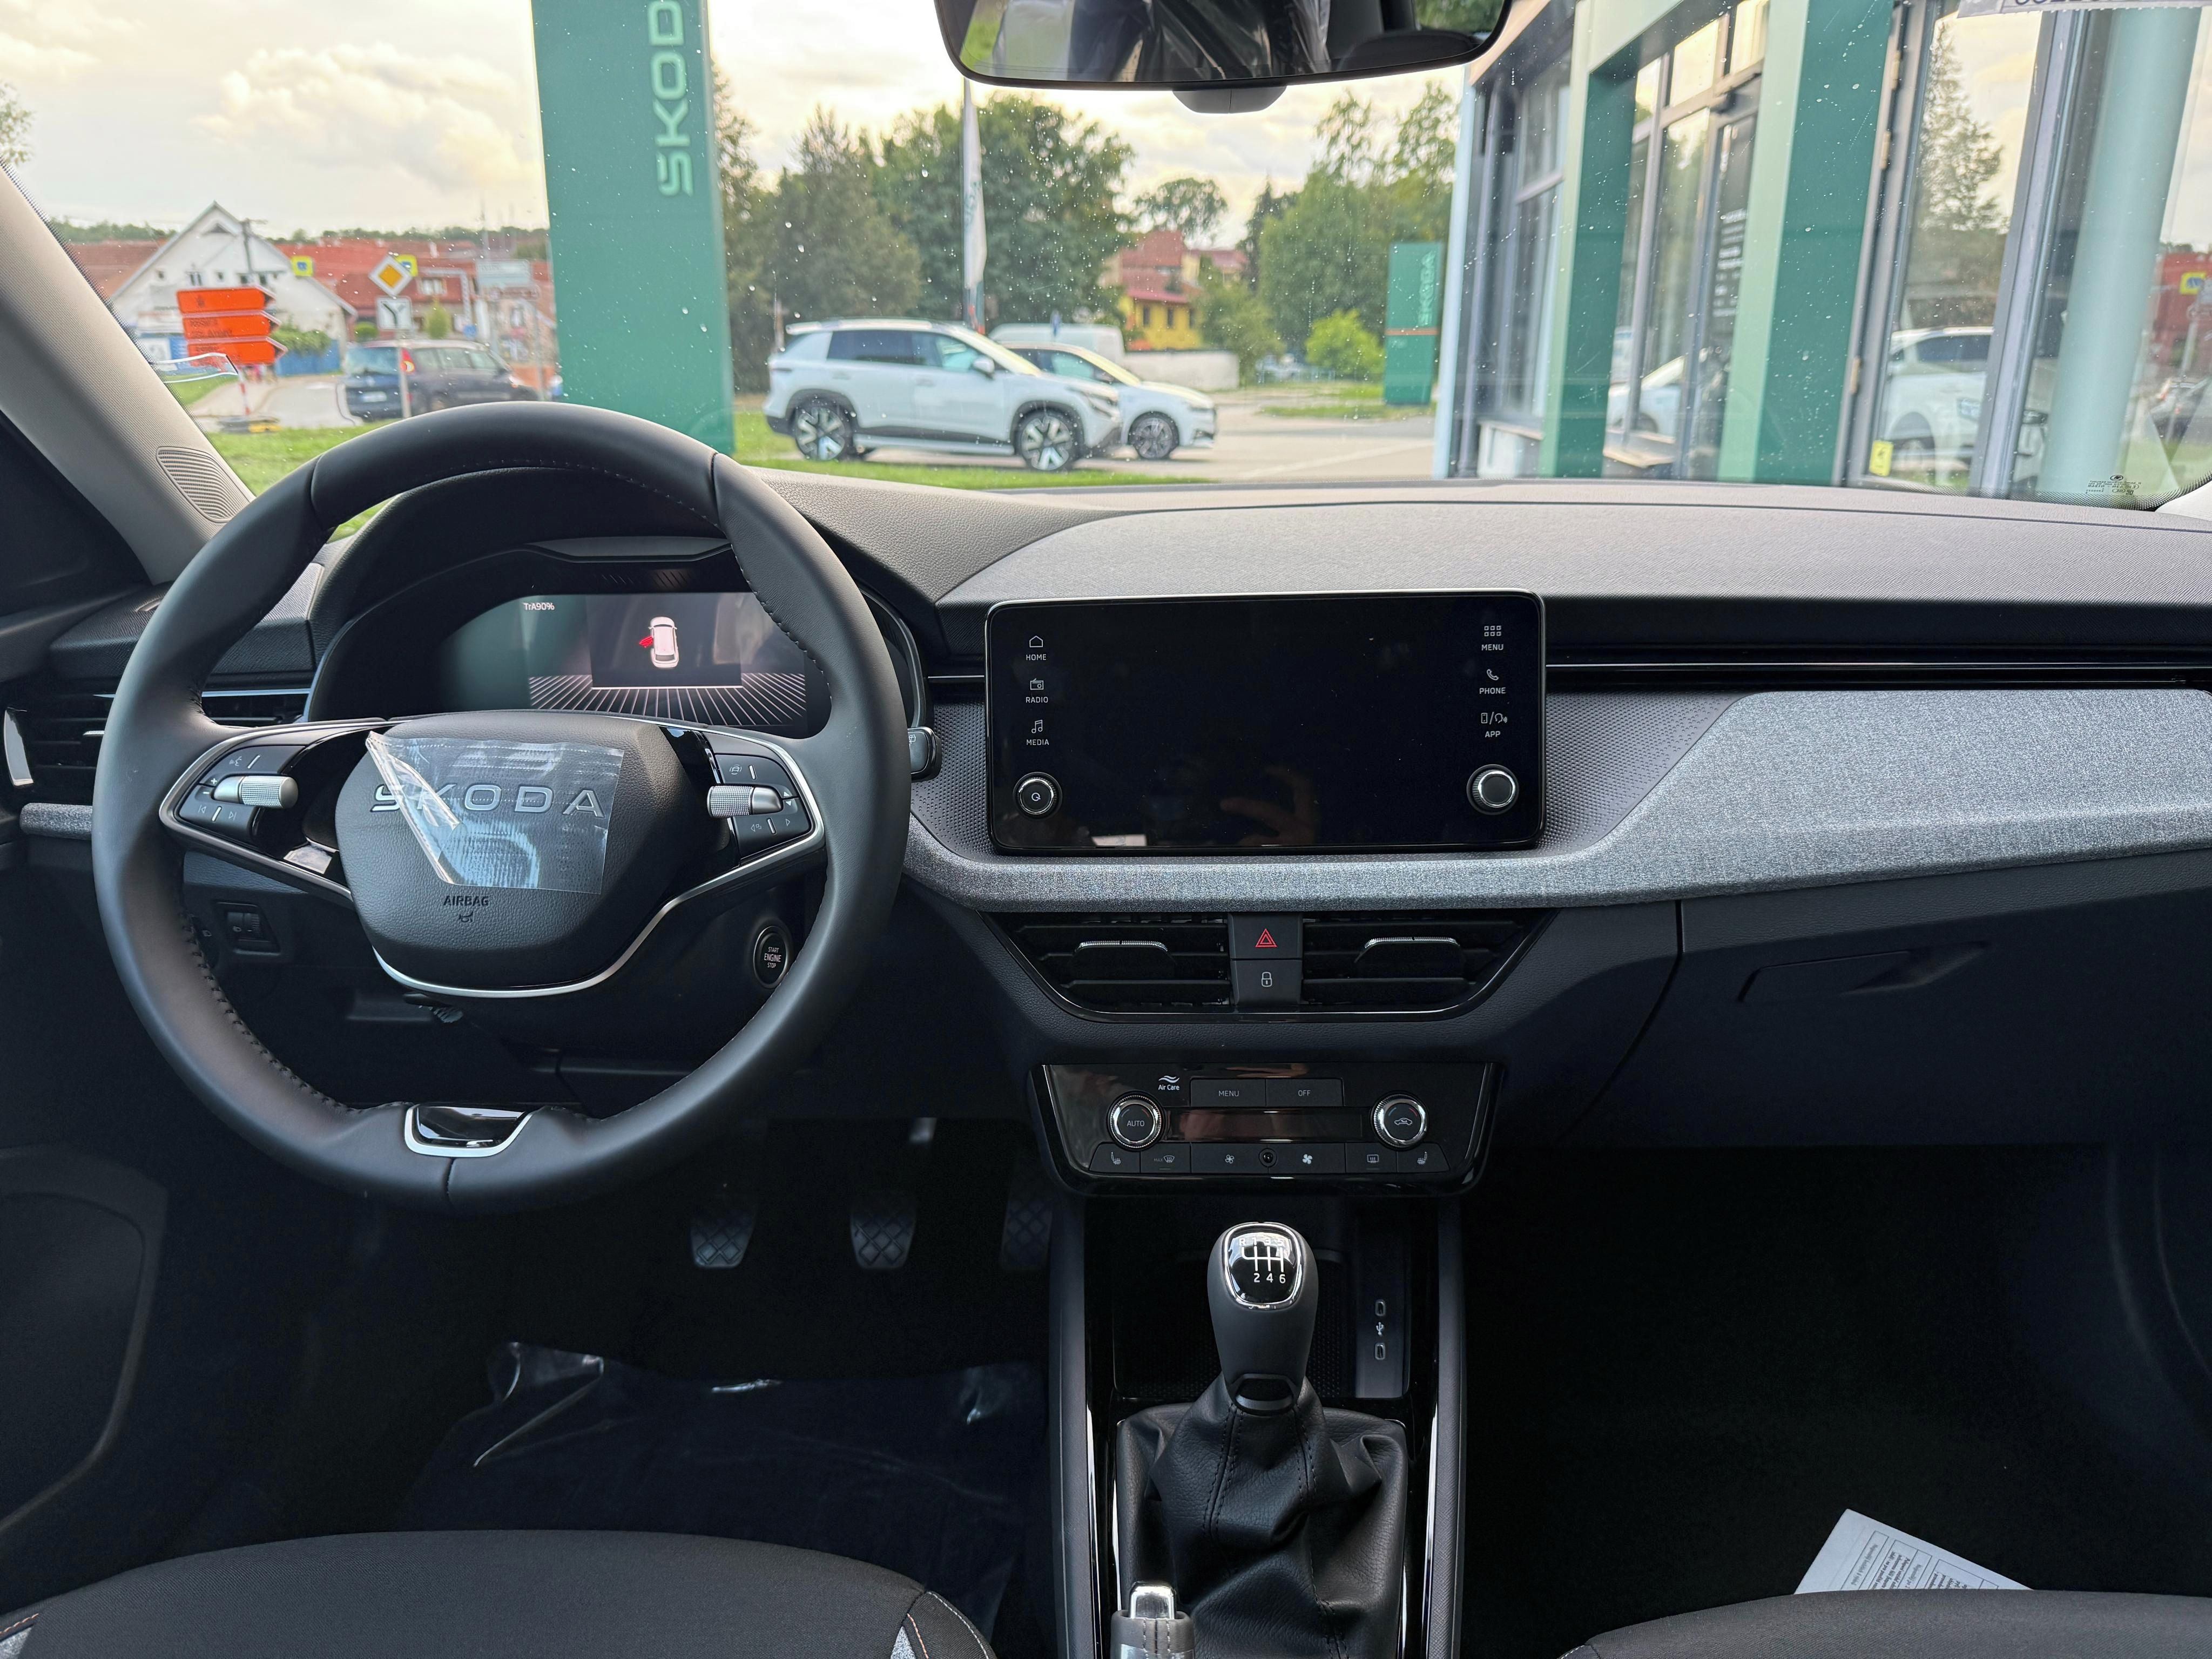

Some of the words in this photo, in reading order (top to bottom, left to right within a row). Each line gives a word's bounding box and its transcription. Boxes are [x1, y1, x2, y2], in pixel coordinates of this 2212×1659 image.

[443, 895, 490, 907] AIRBAG
[764, 953, 782, 962] ENGINE
[1253, 1272, 1260, 1283] 2
[1266, 1273, 1273, 1283] 4
[1279, 1274, 1286, 1284] 6
